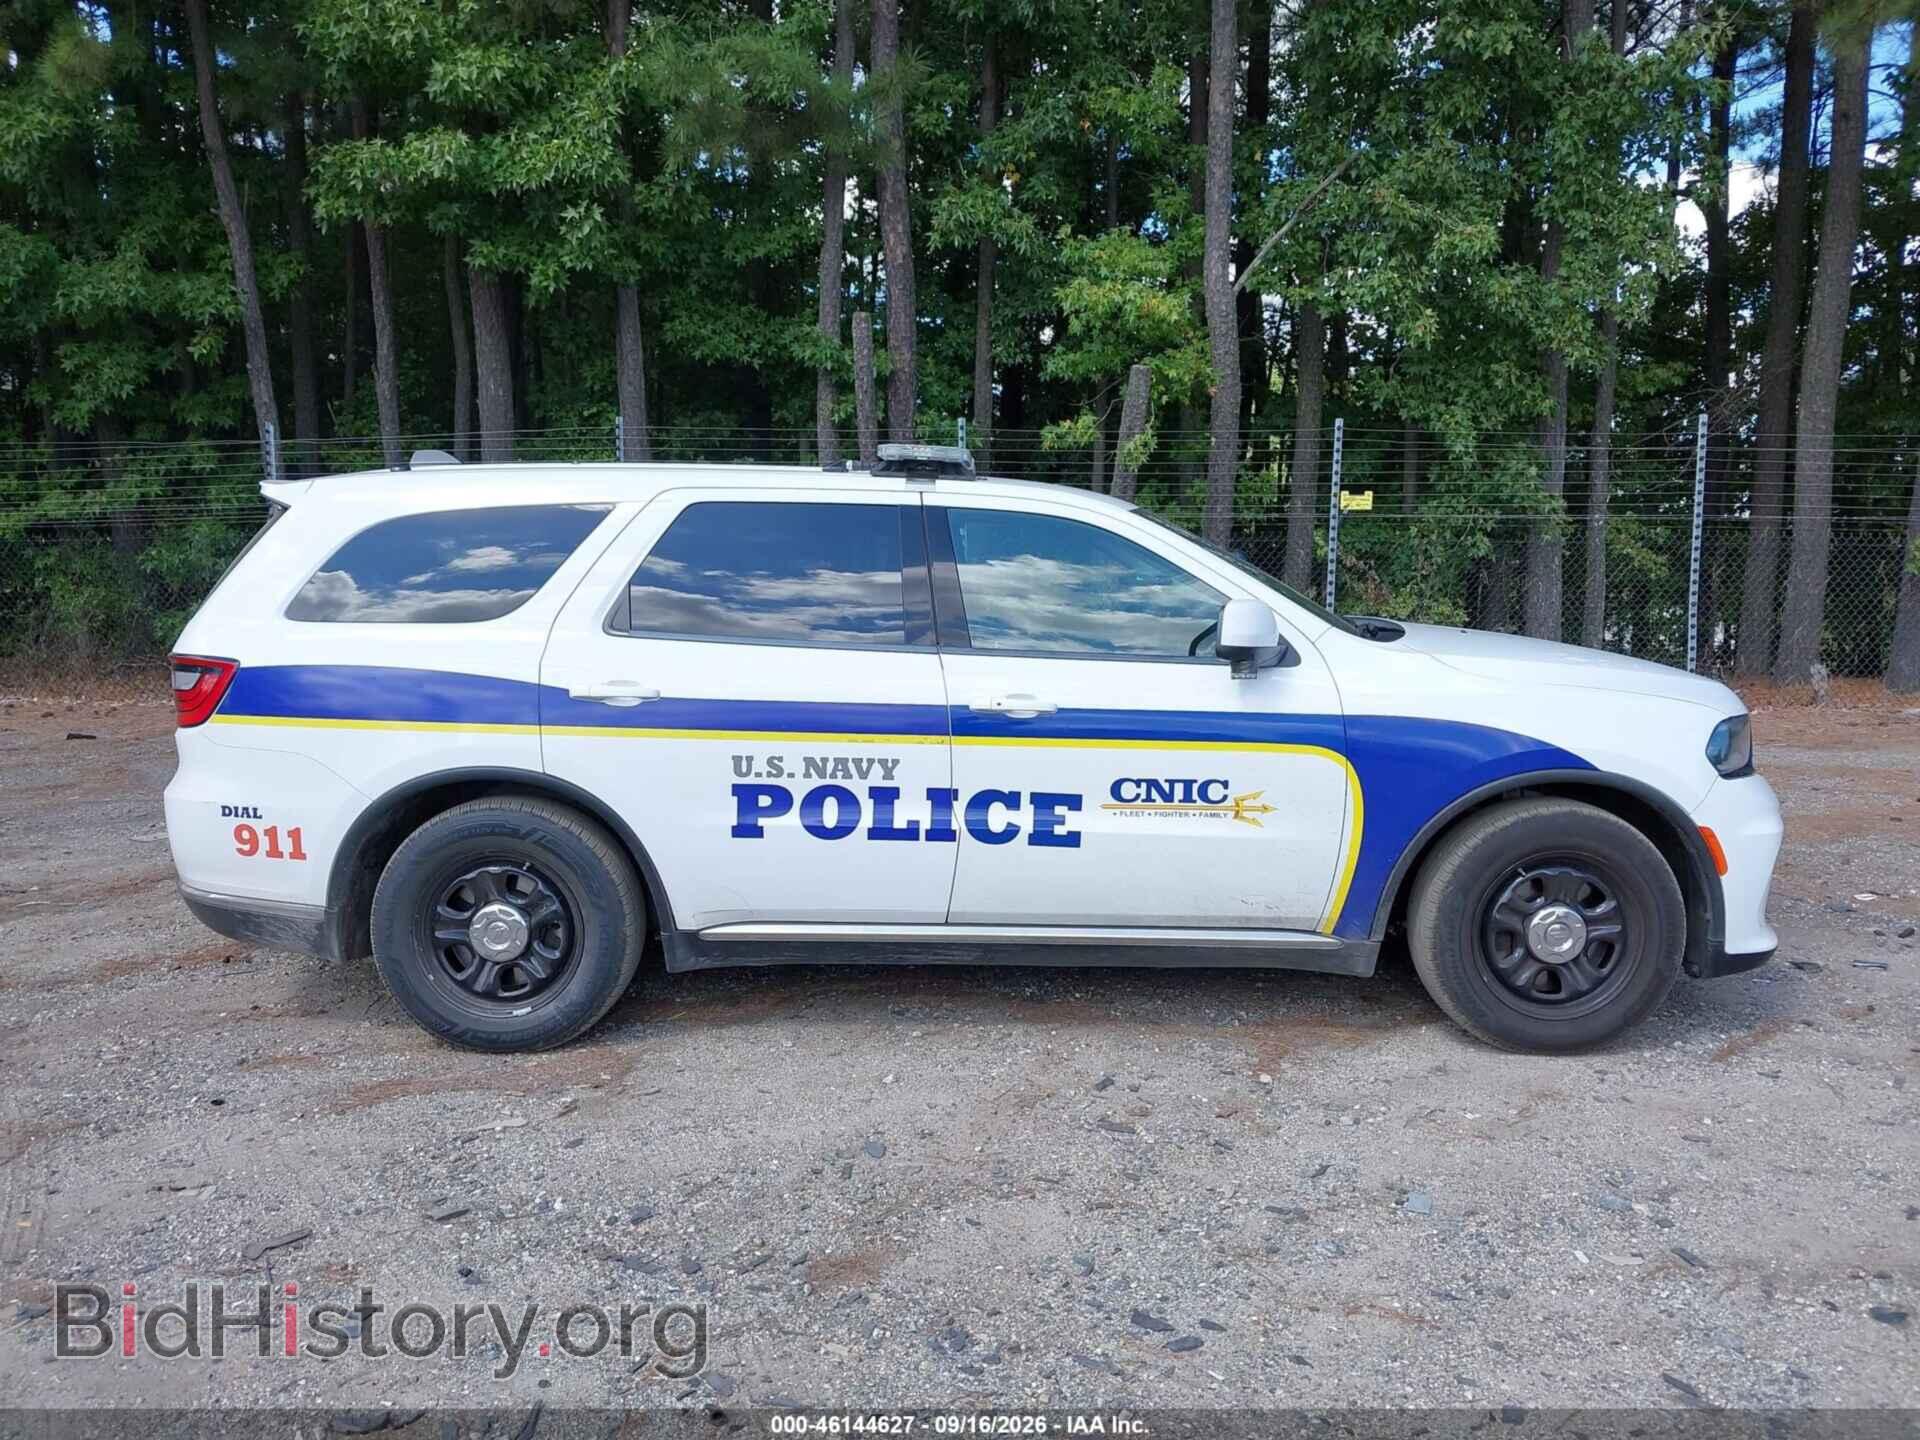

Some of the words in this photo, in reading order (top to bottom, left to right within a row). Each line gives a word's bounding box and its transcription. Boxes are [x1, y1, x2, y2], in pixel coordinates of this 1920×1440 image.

[731, 755, 795, 779] U.S.
[803, 756, 900, 781] NAVY
[1110, 778, 1229, 804] CNIC
[220, 805, 263, 819] DIAL
[731, 783, 1083, 848] POLICE
[233, 823, 307, 861] 911
